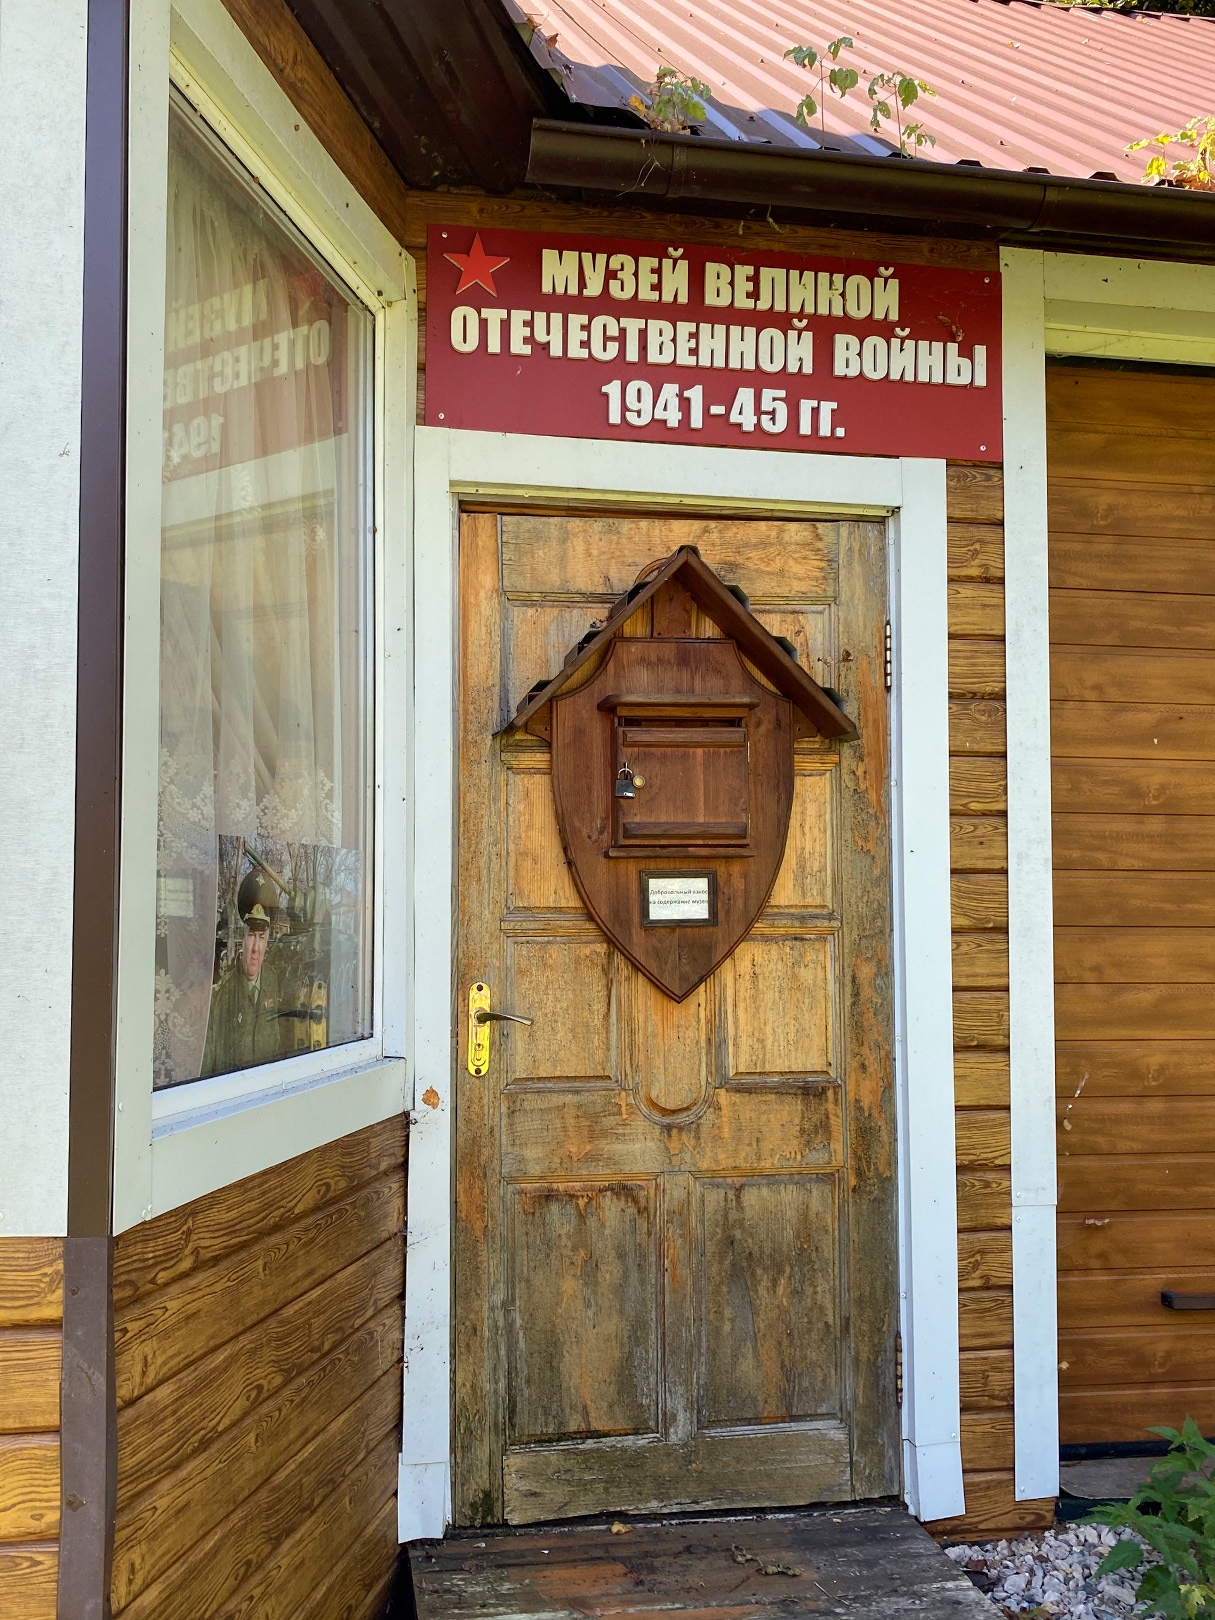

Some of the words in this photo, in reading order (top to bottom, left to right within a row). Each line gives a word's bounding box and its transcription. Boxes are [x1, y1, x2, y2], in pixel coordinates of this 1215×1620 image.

[541, 247, 689, 305] МУЗЕЙ
[703, 262, 900, 322] ВЕЛИКОЙ
[450, 305, 815, 376] ОТЕЧЕСТВЕННОЙ
[832, 327, 988, 389] ВОЙНЫ
[600, 379, 789, 435] 1941-45
